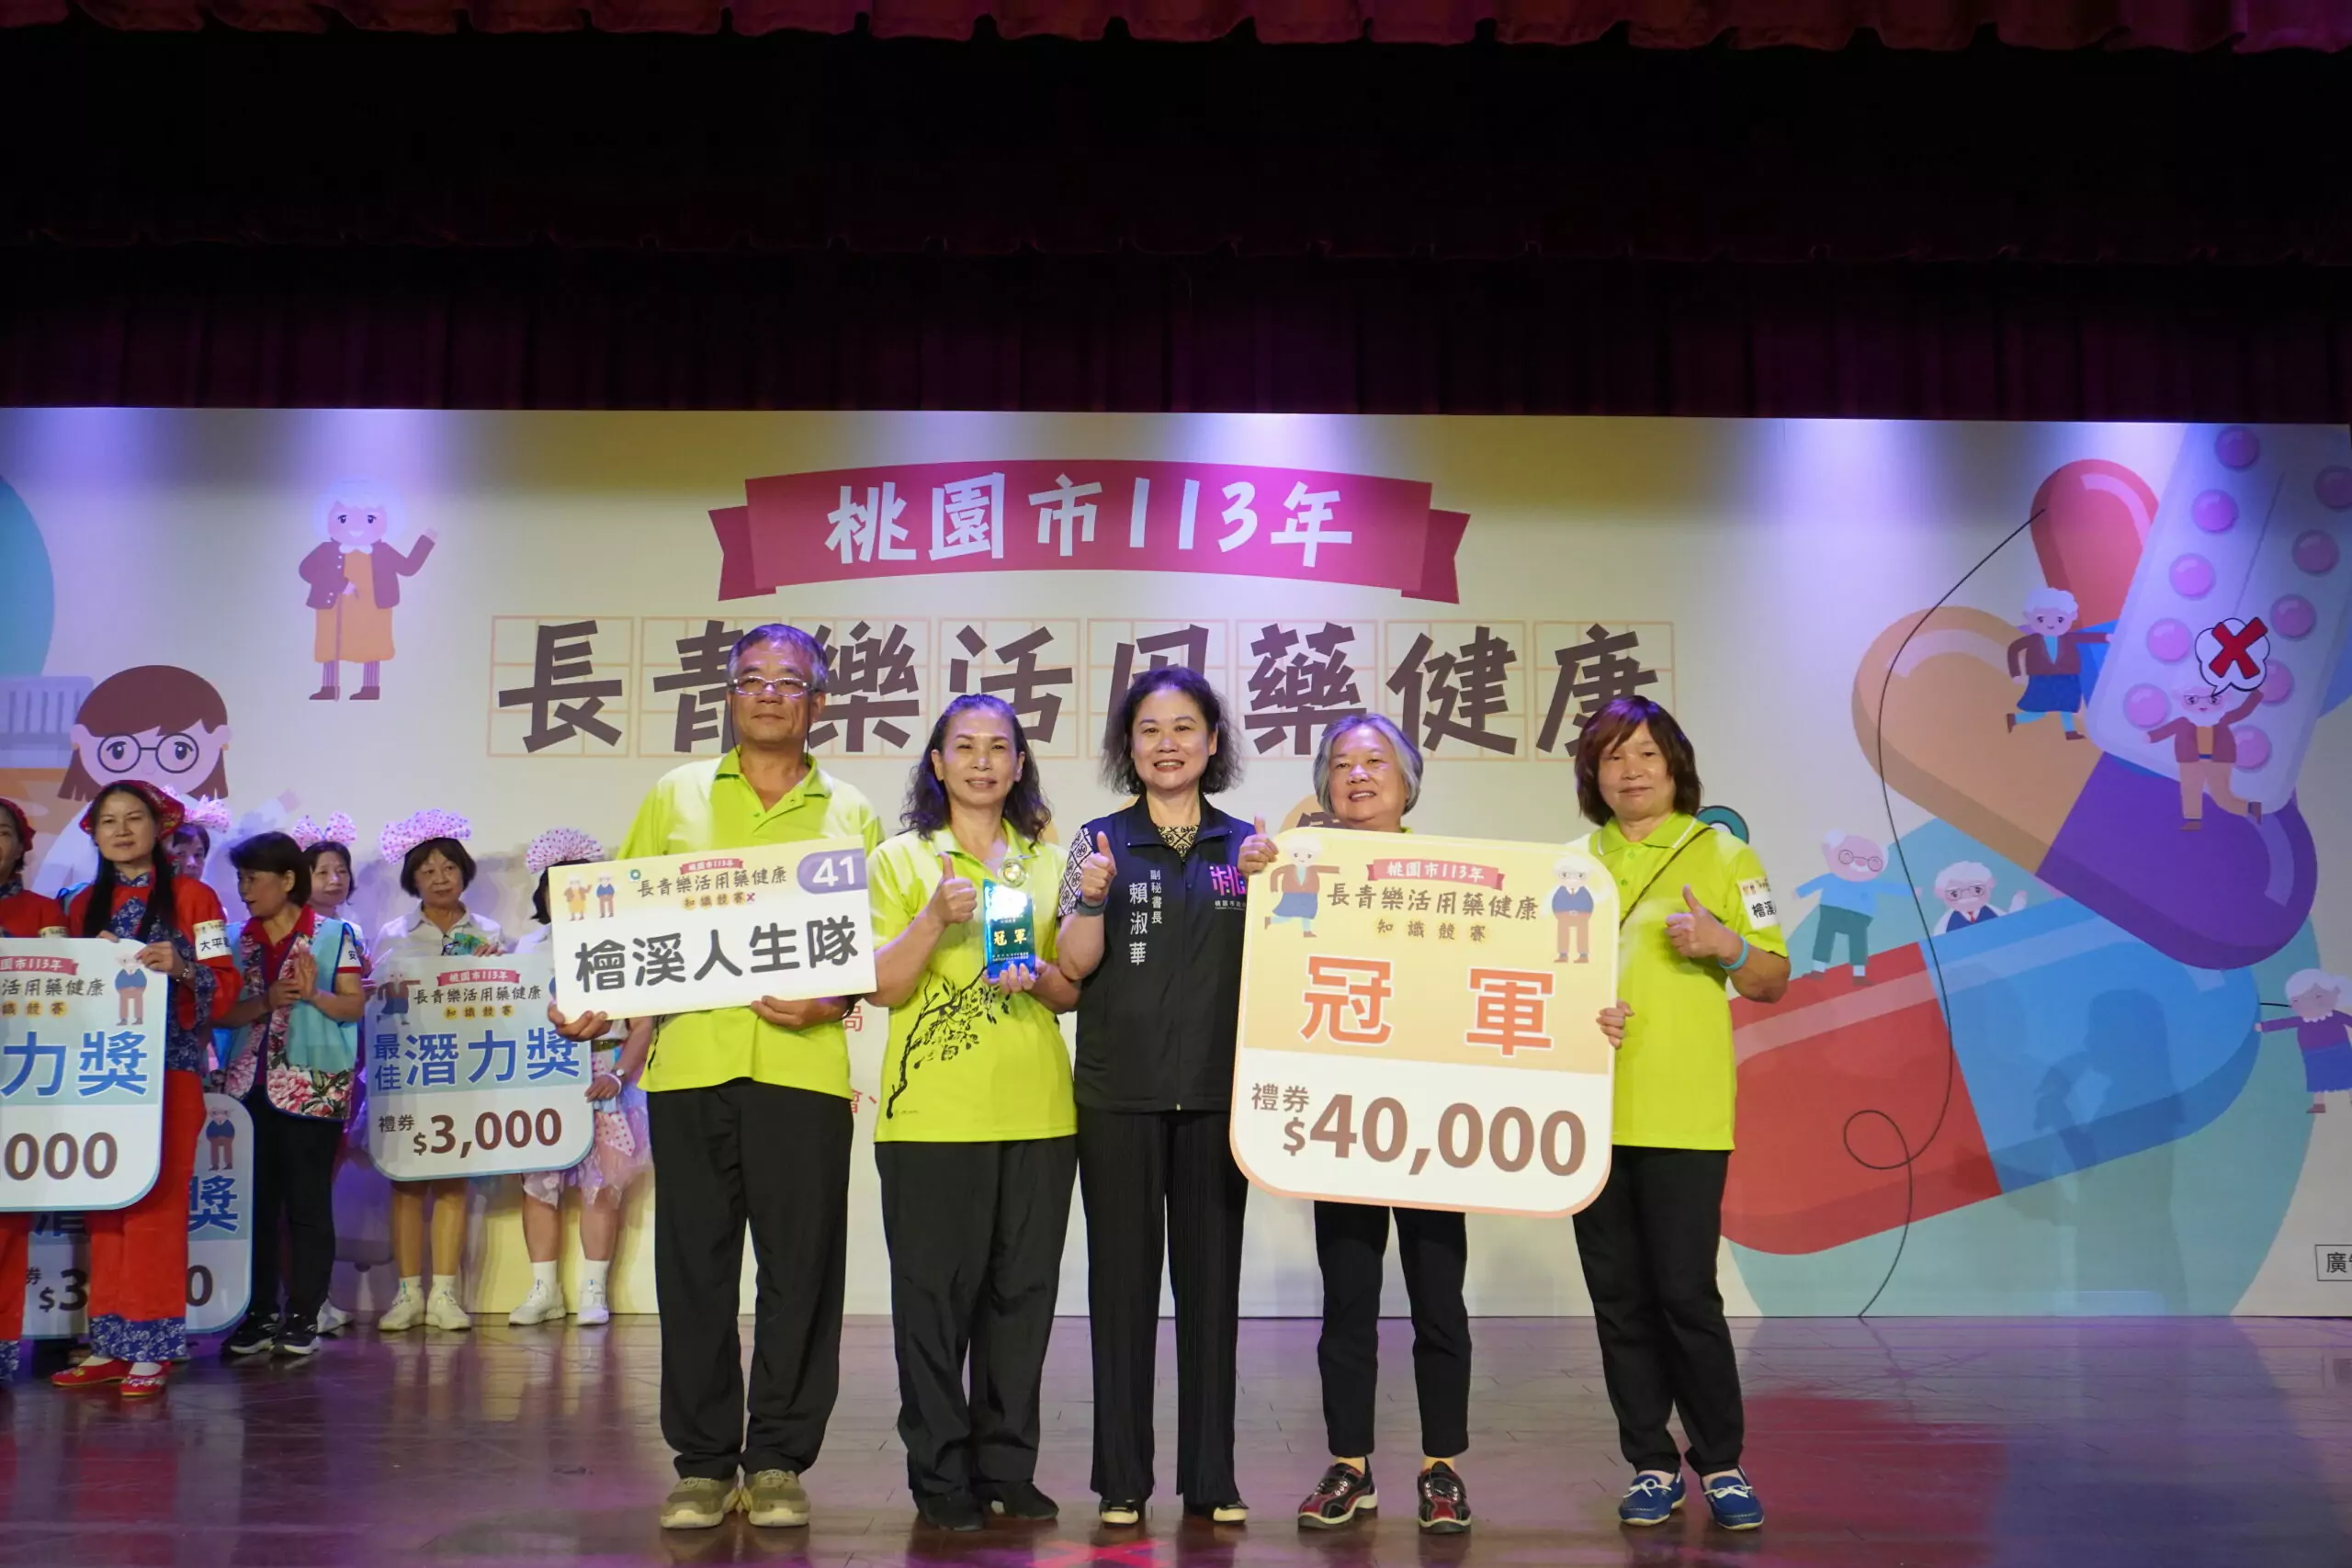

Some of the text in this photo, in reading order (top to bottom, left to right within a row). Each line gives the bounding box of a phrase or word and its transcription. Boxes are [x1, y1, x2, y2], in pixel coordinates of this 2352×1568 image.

[826, 472, 1352, 567] 桃園市113年
[637, 866, 787, 897] 長青樂活用藥健康
[812, 856, 856, 888] 41
[1387, 861, 1485, 882] 桃園市113年
[1149, 869, 1162, 925] 副秘書長
[1327, 883, 1539, 920] 長青樂活用藥健康
[994, 928, 1027, 946] 冠軍
[1129, 882, 1148, 966] 賴淑華
[1377, 919, 1486, 942] 知識競賽
[575, 915, 858, 993] 檜溪人生隊
[2, 977, 106, 997] 活用藥健康
[413, 984, 542, 1005] 長青樂活用藥健康
[1299, 955, 1555, 1057] 冠軍
[1, 1030, 149, 1098] 力獎
[1250, 1082, 1309, 1113] 禮券
[378, 1113, 415, 1134] 禮券
[413, 1108, 562, 1159] $3,000
[1283, 1093, 1587, 1177] $40,000
[4, 1132, 119, 1181] 000
[2326, 1252, 2352, 1274] 廣
